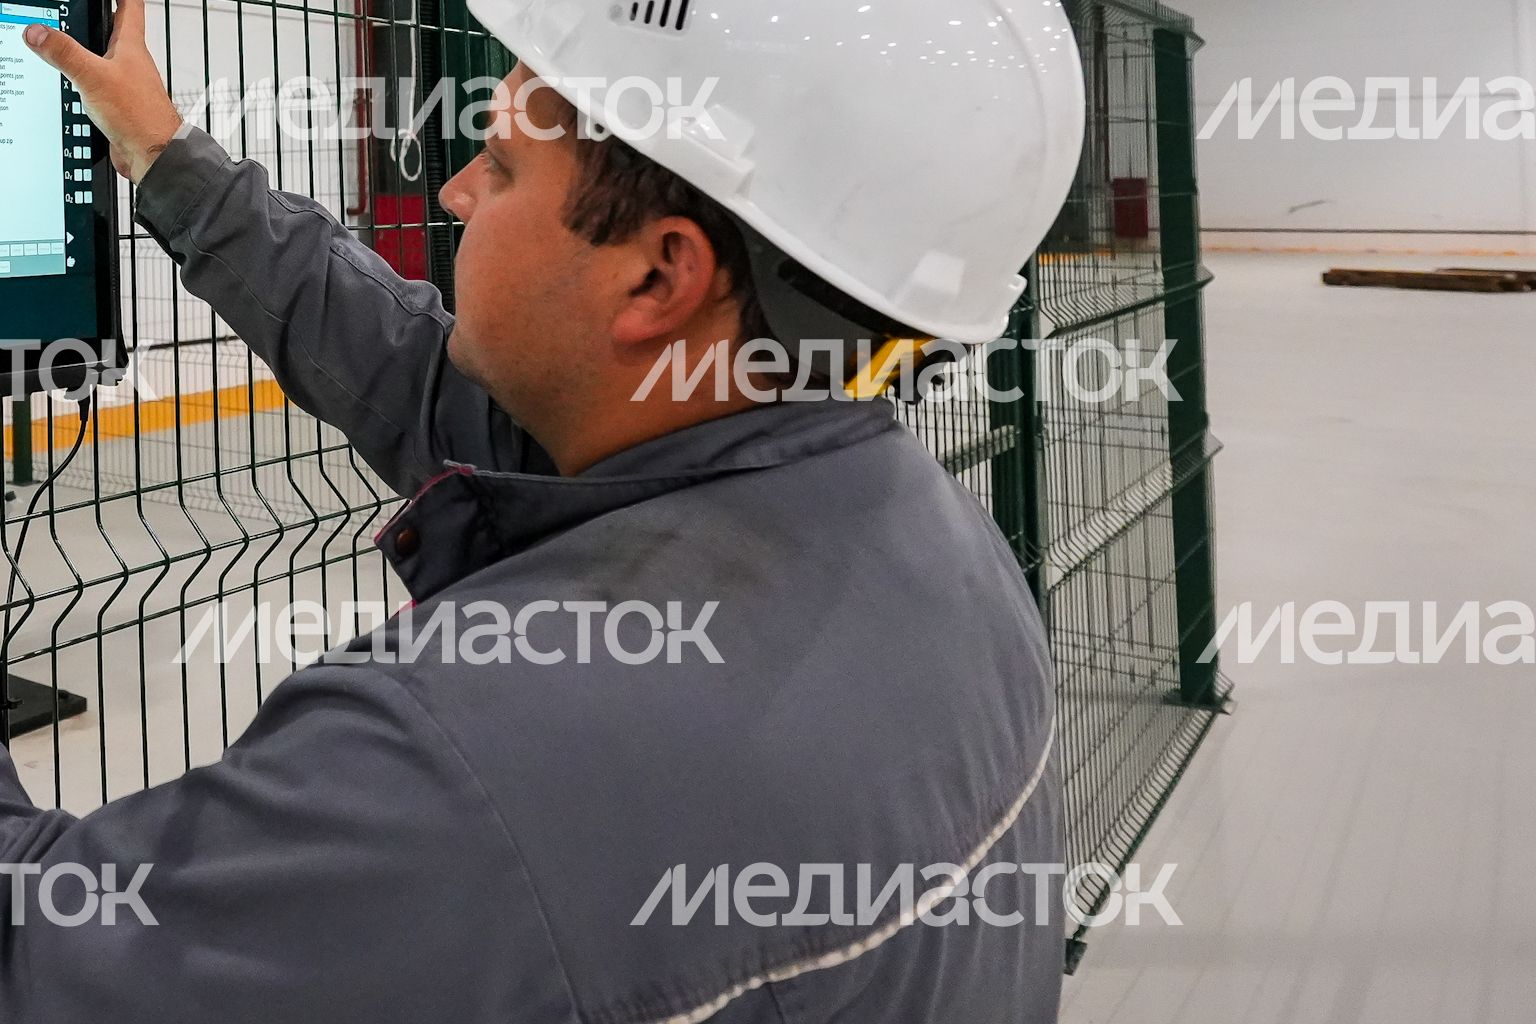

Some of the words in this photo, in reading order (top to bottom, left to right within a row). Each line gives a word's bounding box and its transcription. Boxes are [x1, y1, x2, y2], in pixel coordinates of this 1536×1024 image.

[63, 80, 69, 90] X
[64, 102, 70, 112] Y
[64, 125, 70, 134] Z
